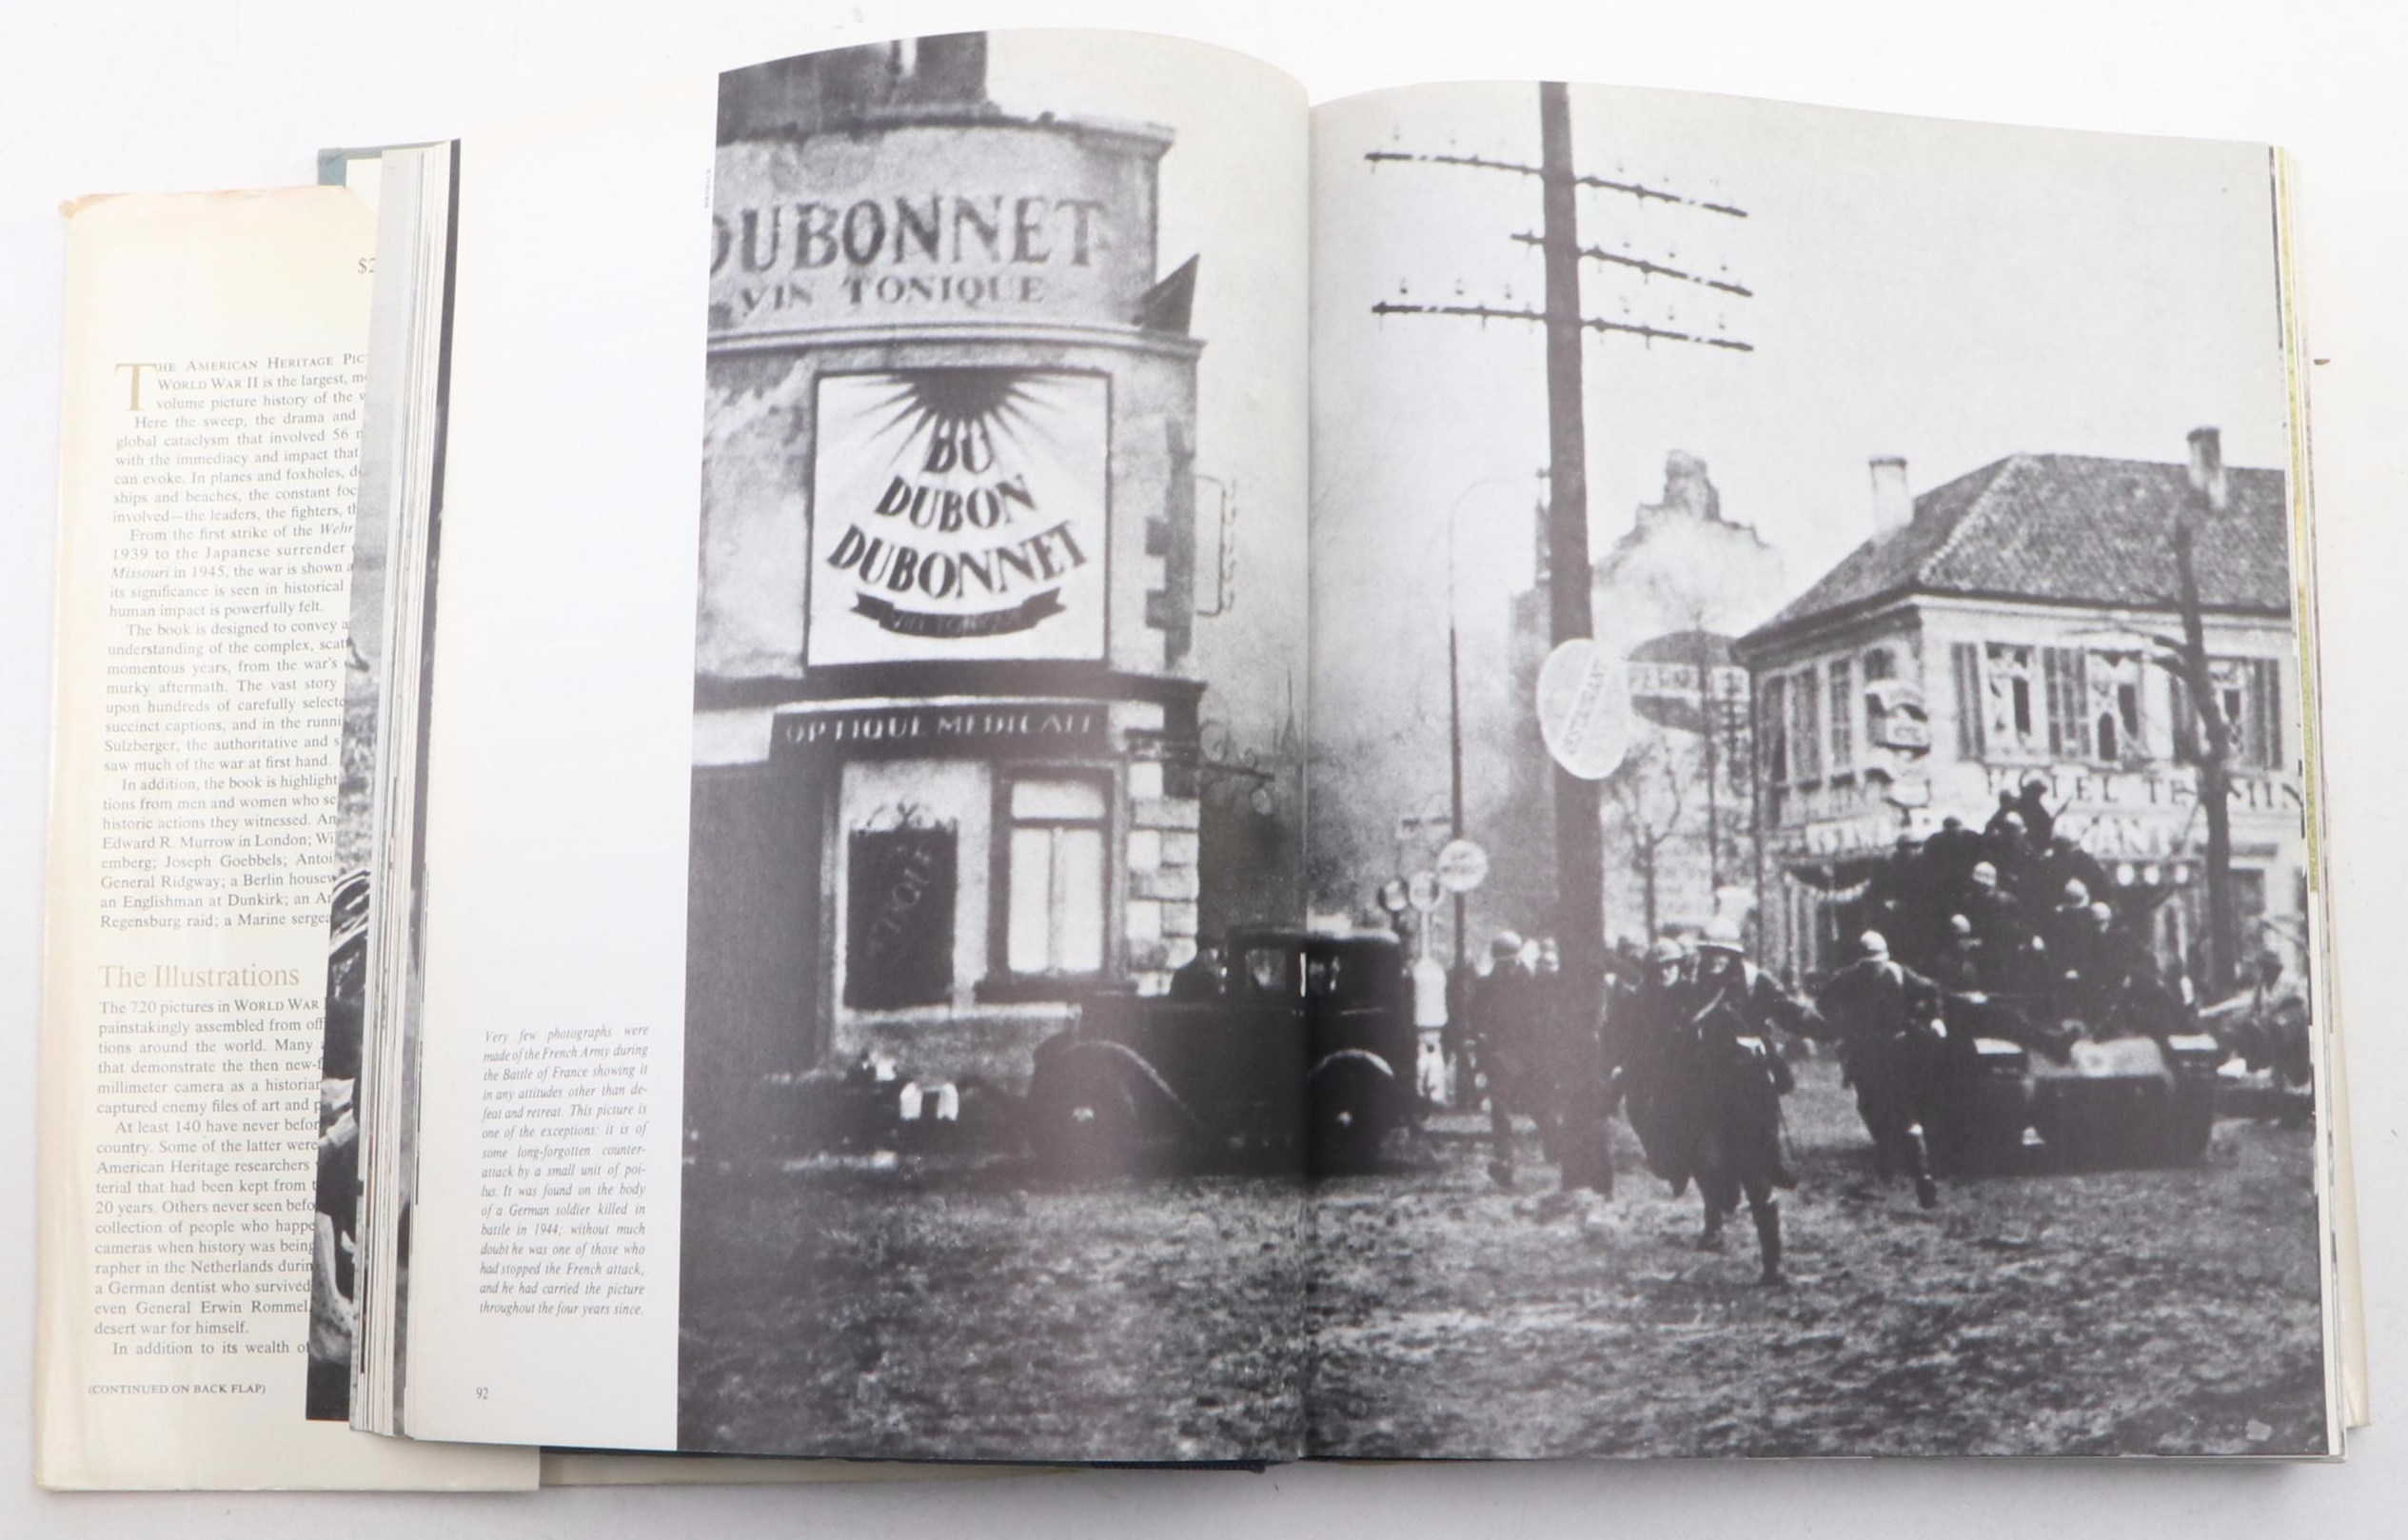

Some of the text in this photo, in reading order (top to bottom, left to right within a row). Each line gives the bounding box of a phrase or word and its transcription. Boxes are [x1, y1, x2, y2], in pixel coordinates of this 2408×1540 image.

[740, 275, 1045, 316] VIN TONIQUE
[343, 352, 368, 365] PIC
[247, 377, 258, 388] II
[263, 376, 273, 387] is
[277, 375, 298, 387] the
[301, 375, 348, 388] largest,
[156, 391, 354, 412] volume picture history of the
[873, 473, 1038, 533] DUBON
[113, 543, 345, 562] 1939 to the Japanese surrender
[826, 521, 1087, 599] DUBONNET
[100, 876, 155, 888] General
[161, 875, 227, 891] Ridgway;
[230, 878, 238, 886] a
[243, 874, 285, 886] Berlin
[98, 963, 300, 988] The Illustrations
[100, 1001, 127, 1015] The
[131, 1001, 157, 1015] 720
[160, 1001, 214, 1017] pictures
[217, 999, 230, 1013] in
[484, 1025, 649, 1045] Very few photographs were
[483, 1043, 649, 1064] made of the French Army during
[483, 1063, 649, 1082] the Battle of France showing it
[483, 1082, 648, 1102] in any attitudes other than de-
[482, 1107, 503, 1122] feat
[504, 1106, 525, 1118] and
[570, 1104, 592, 1116] This
[595, 1106, 634, 1119] picture
[638, 1103, 647, 1114] is
[482, 1130, 501, 1138] one
[503, 1125, 516, 1140] of
[519, 1125, 535, 1137] the
[605, 1123, 615, 1135] it
[620, 1123, 629, 1135] is
[635, 1121, 647, 1137] of
[482, 1144, 646, 1160] some long-forgotten counter-
[96, 1158, 310, 1175] American Heritage researchers
[481, 1162, 646, 1179] attack by a small unit of poi-
[503, 1184, 513, 1196] It
[517, 1188, 538, 1196] was
[542, 1183, 574, 1199] found
[578, 1187, 592, 1195] on
[597, 1182, 614, 1195] the
[619, 1182, 646, 1197] body
[481, 1202, 646, 1219] of a German soldier killed in
[481, 1223, 511, 1235] battle
[517, 1224, 528, 1235] in
[570, 1222, 610, 1235] without
[616, 1222, 646, 1234] much
[480, 1242, 646, 1258] doubt he was one of those who
[95, 1261, 141, 1277] rapher
[147, 1260, 159, 1273] in
[164, 1261, 187, 1273] the
[190, 1260, 274, 1273] Netherlands
[480, 1262, 500, 1273] had
[501, 1262, 542, 1277] stopped
[544, 1262, 562, 1274] the
[566, 1262, 602, 1274] French
[94, 1278, 311, 1294] a German dentist who survived
[479, 1280, 645, 1297] and he had carried the picture
[94, 1305, 127, 1314] even
[135, 1300, 191, 1314] General
[200, 1301, 243, 1313] Erwin
[479, 1300, 644, 1317] throughout the four years since.
[170, 1384, 190, 1393] ON
[193, 1384, 228, 1393] BACK
[230, 1384, 266, 1394] FLAP)
[476, 1387, 489, 1400] 92
